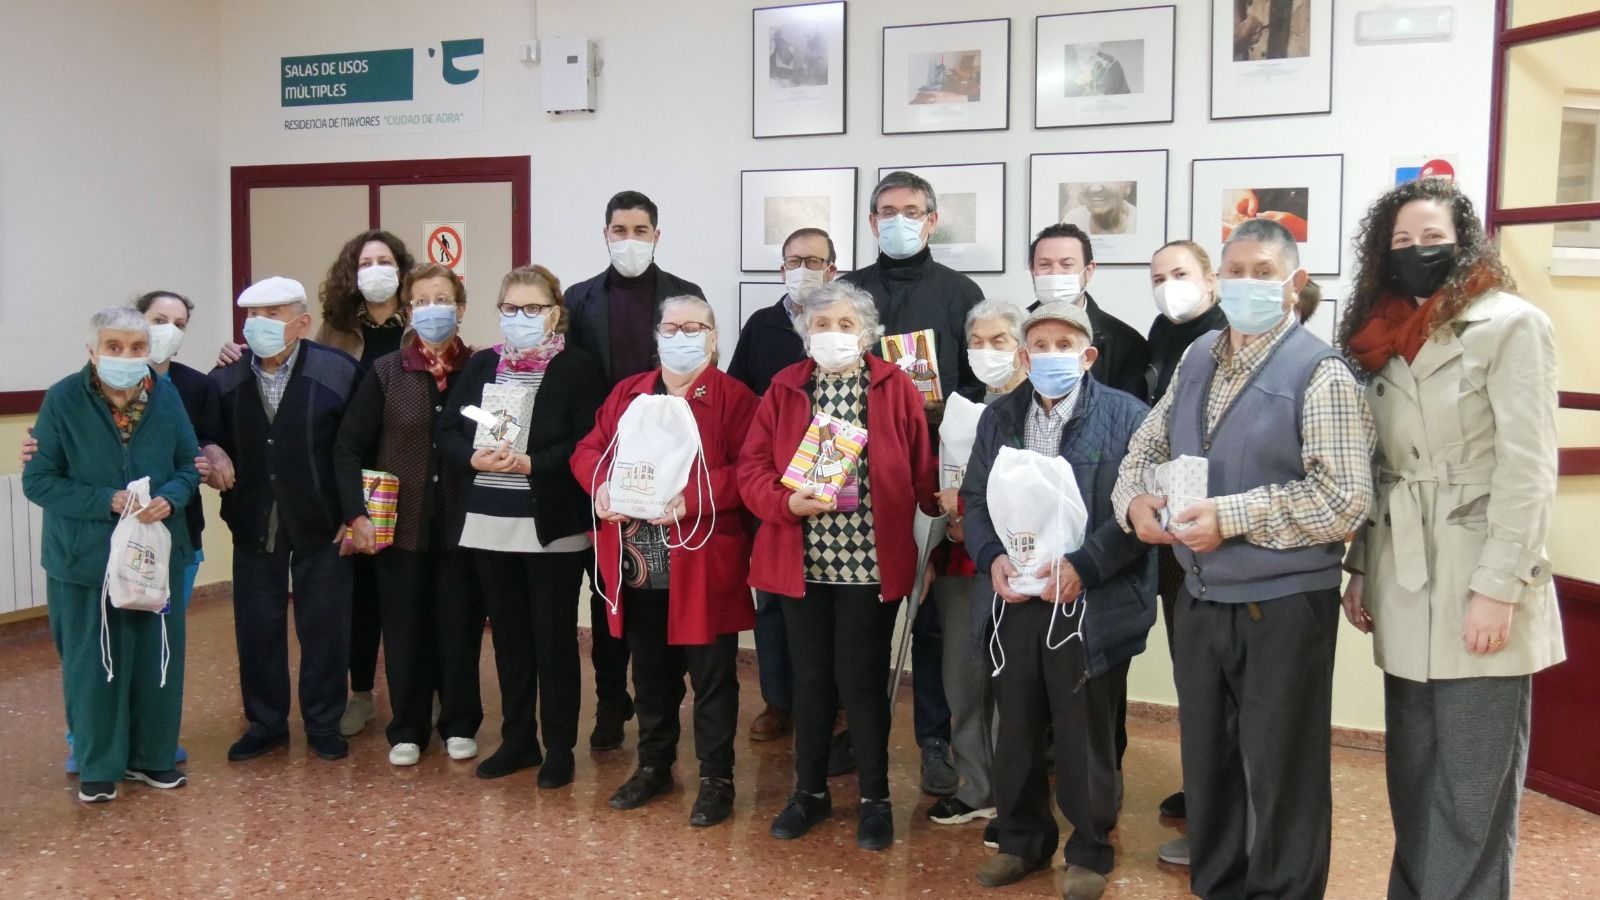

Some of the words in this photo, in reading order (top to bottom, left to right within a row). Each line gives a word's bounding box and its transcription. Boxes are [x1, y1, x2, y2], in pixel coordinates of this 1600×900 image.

[285, 63, 319, 78] SALAS
[321, 62, 336, 76] DE
[339, 59, 369, 74] USOS
[284, 118, 327, 131] RESIDENCIA
[329, 117, 339, 129] DE
[341, 115, 380, 128] MAYORES
[421, 113, 433, 125] DE
